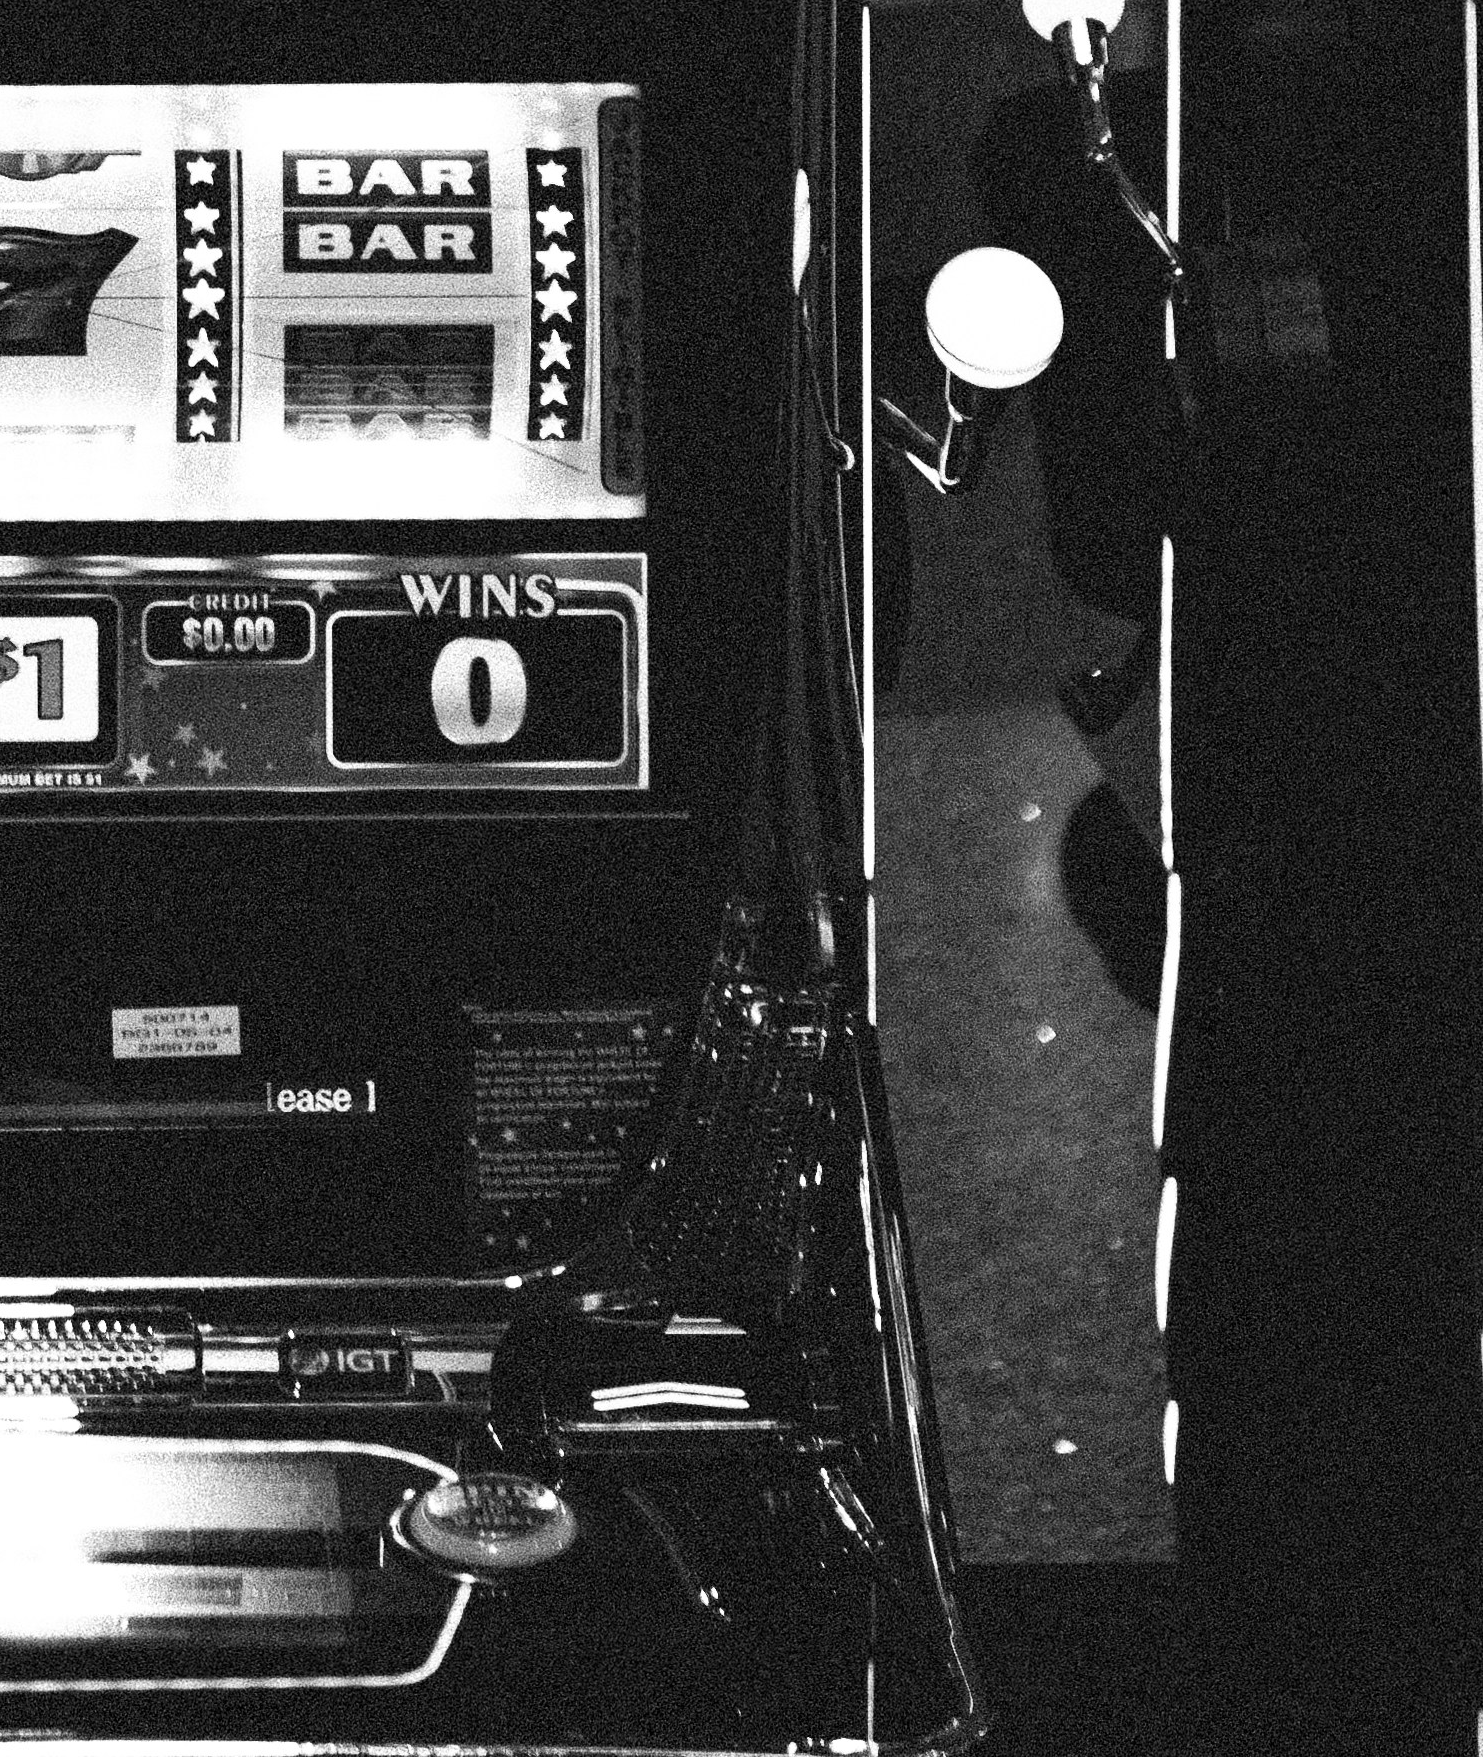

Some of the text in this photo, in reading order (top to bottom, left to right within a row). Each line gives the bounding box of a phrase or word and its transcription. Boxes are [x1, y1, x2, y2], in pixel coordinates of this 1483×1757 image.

[296, 159, 476, 195] BAR
[298, 225, 476, 260] BAR
[189, 594, 271, 611] CREDIT
[400, 574, 557, 618] WINS
[183, 617, 275, 652] $0.00
[431, 637, 527, 745] 0
[337, 1350, 398, 1373] IGT
